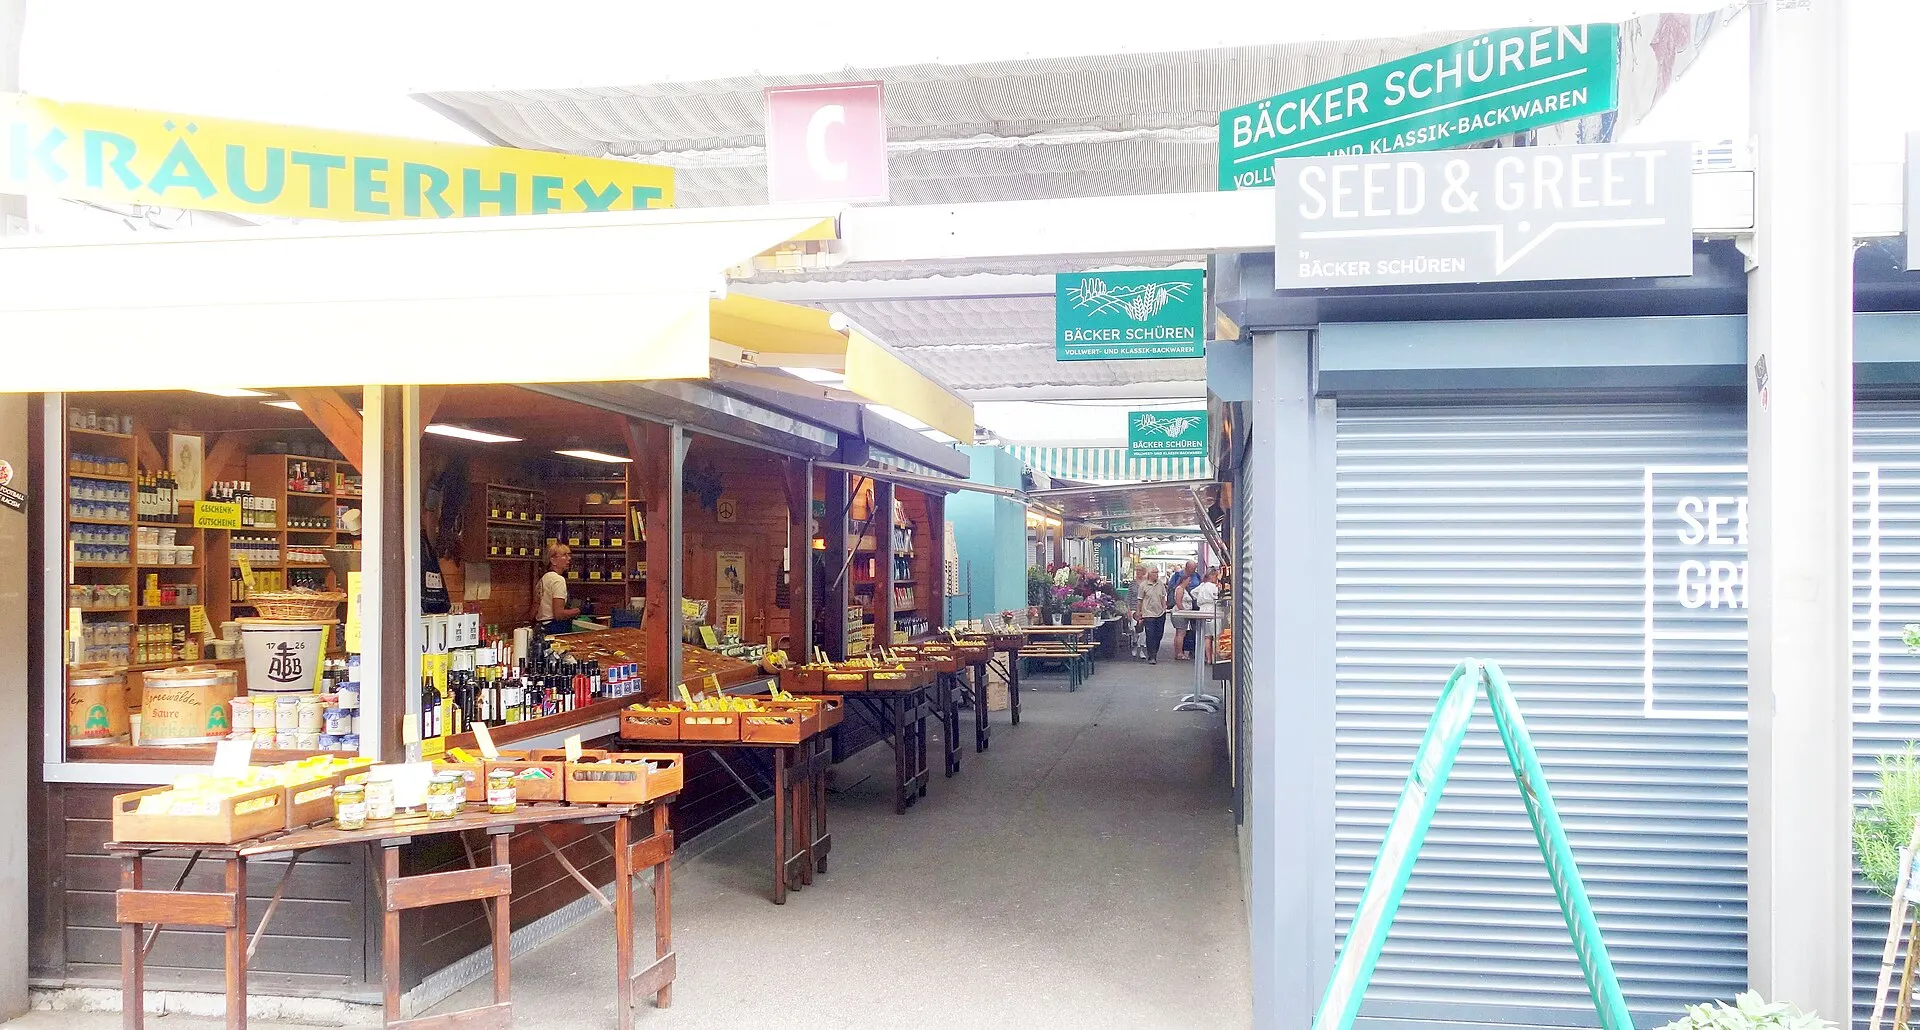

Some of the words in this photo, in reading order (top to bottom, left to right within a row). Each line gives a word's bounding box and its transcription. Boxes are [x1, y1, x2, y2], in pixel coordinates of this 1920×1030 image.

[1233, 82, 1369, 148] BÄCKER
[1384, 24, 1588, 106] SCHÜREN
[1371, 87, 1588, 156] KLASSIK-BACKWAREN
[805, 104, 849, 181] C
[1298, 160, 1427, 221] SEED
[1440, 158, 1479, 214] &
[1494, 150, 1667, 212] GREET
[1299, 260, 1371, 278] BÄCKER
[1377, 255, 1466, 275] SCHÜREN
[1064, 327, 1121, 342] BÄCKER
[1125, 325, 1195, 340] SCHÜREN
[1120, 346, 1195, 354] KLASSIK-BACKWAREN
[1132, 440, 1164, 449] BÄCKER
[1165, 439, 1203, 448] SCHÜREN
[200, 505, 234, 514] GESCHENK-
[198, 517, 236, 527] GUTSCHEINE
[265, 642, 276, 650] 17
[295, 641, 306, 650] 26
[268, 656, 303, 677] ABB
